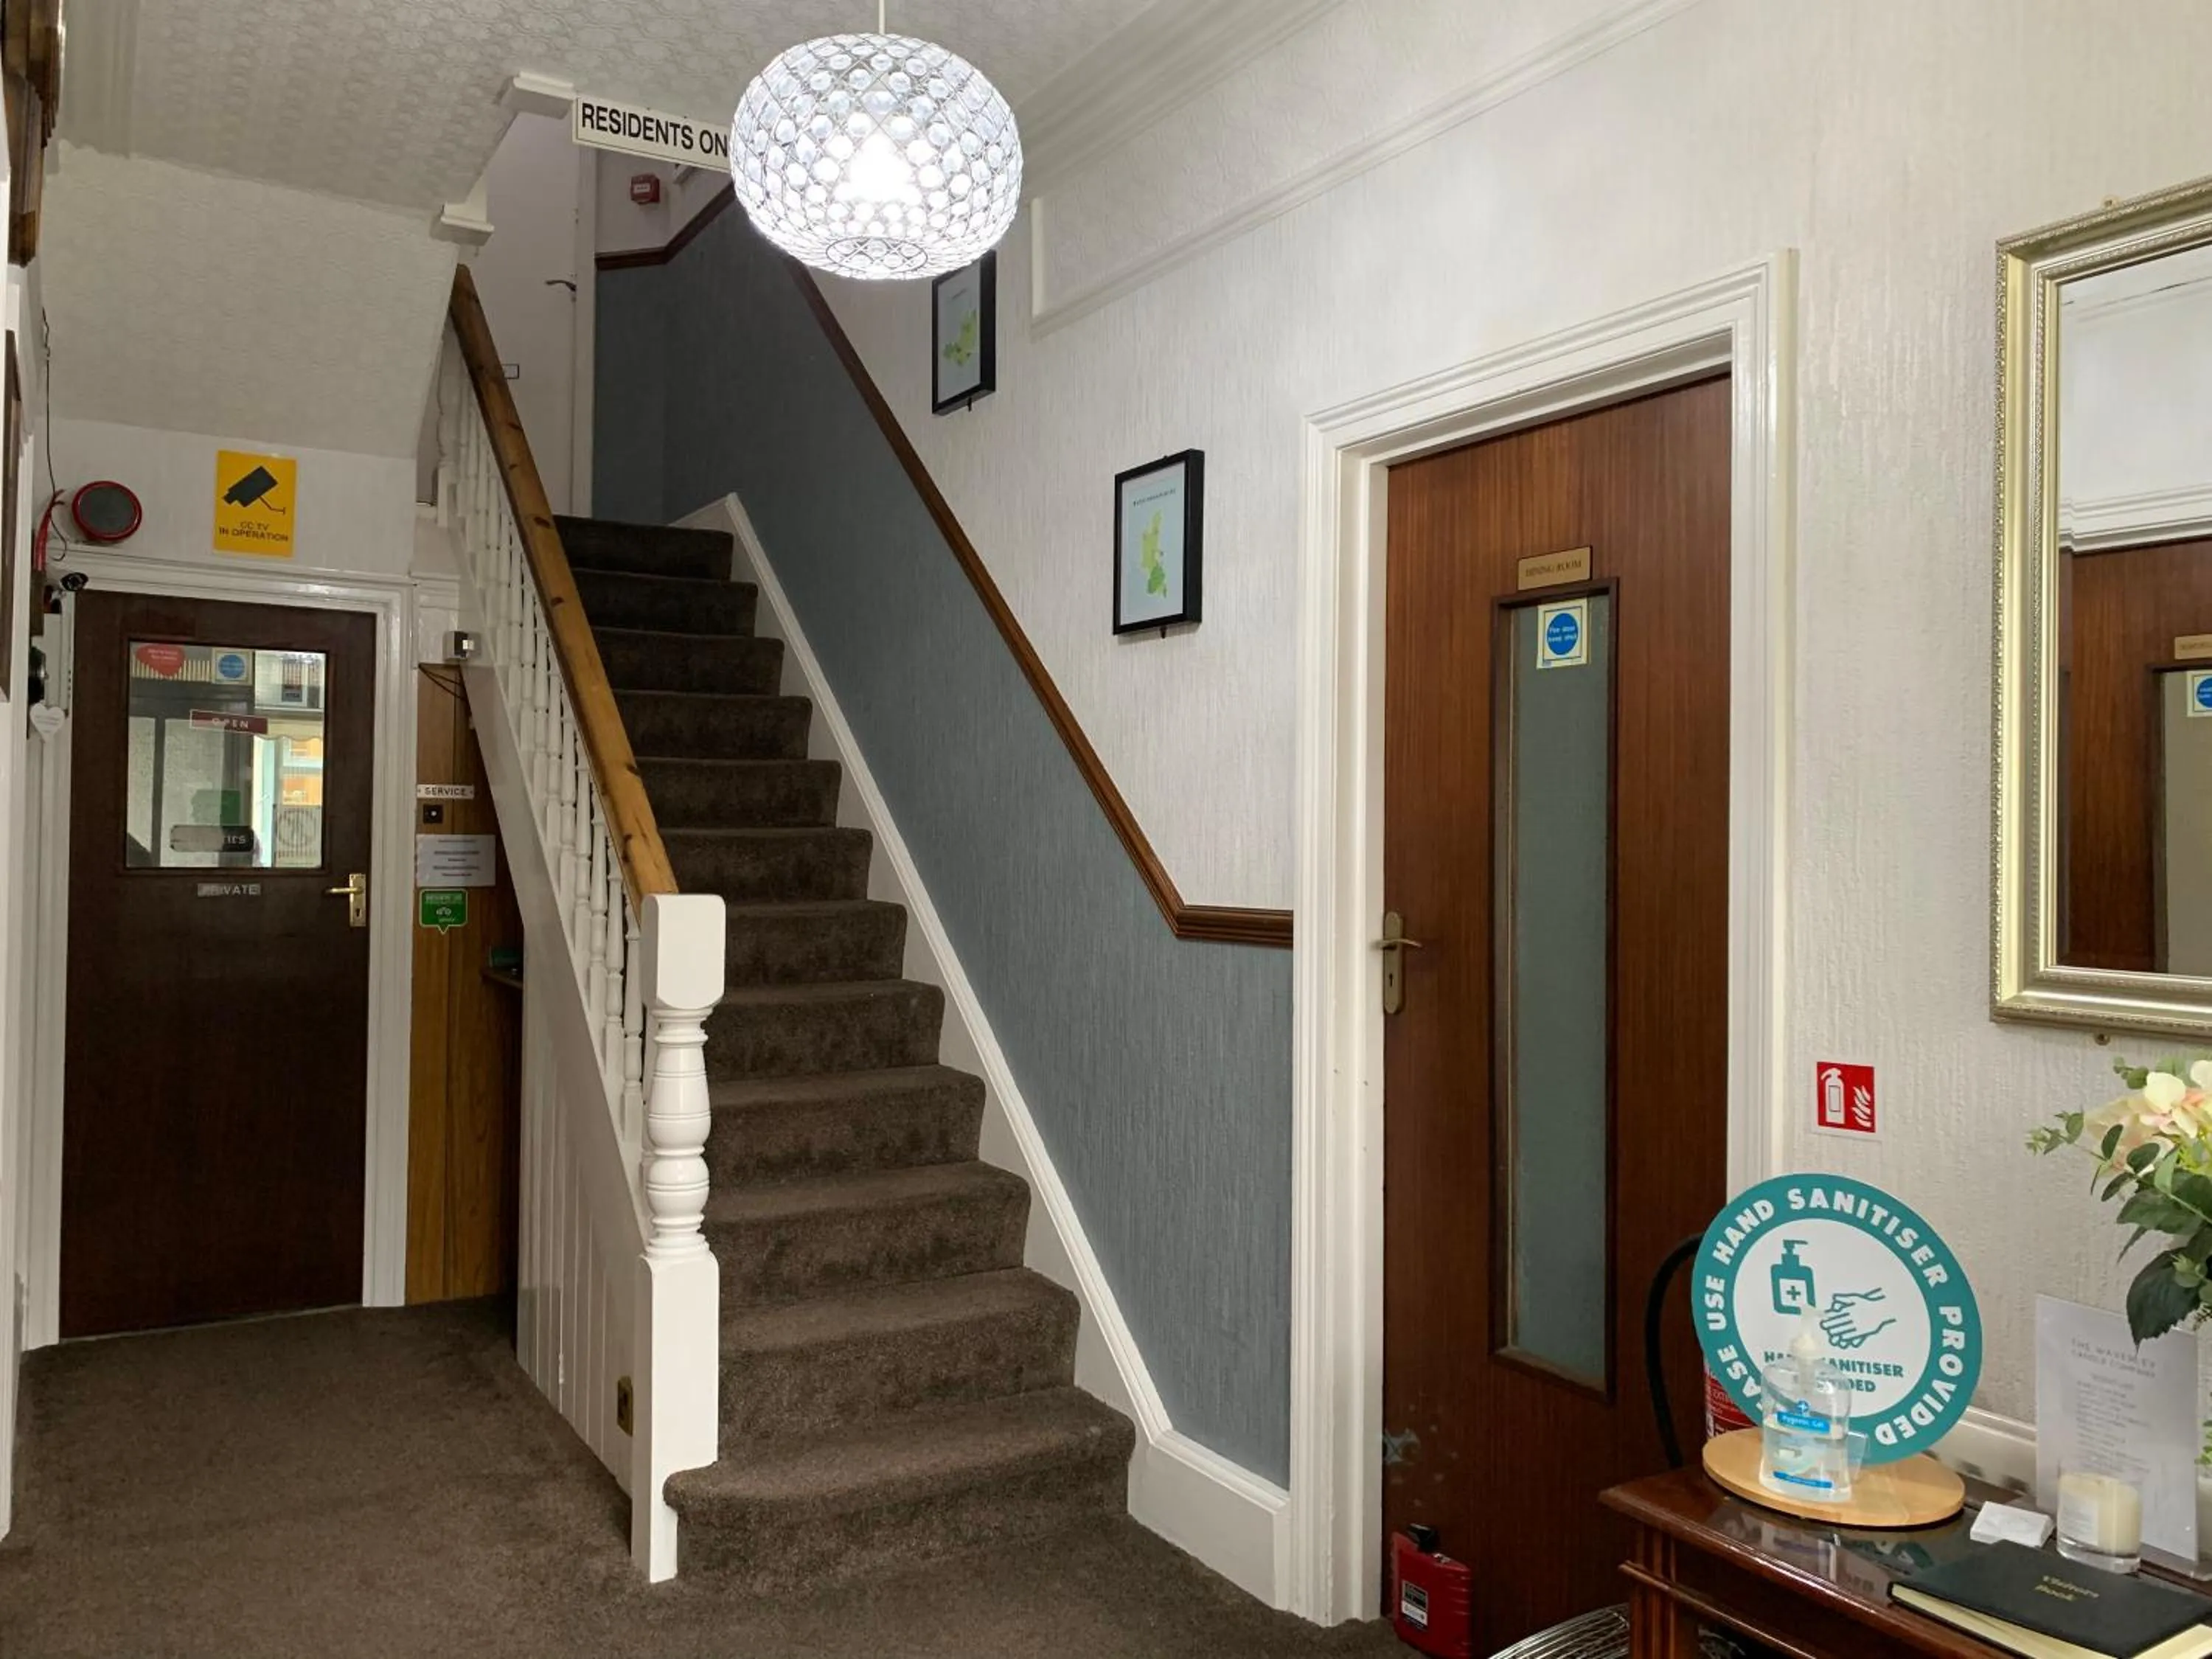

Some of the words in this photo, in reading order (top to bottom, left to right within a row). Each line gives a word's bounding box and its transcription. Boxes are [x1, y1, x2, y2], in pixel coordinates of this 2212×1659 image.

[582, 102, 694, 150] RESIDENTS
[699, 130, 728, 157] ON
[232, 529, 288, 542] OPERATION
[212, 717, 248, 728] OPEN
[424, 787, 467, 796] SERVICE
[1712, 1199, 1775, 1266] HAND
[1787, 1188, 1949, 1288] SANITISER
[1704, 1275, 1727, 1331] USE
[1823, 1357, 1904, 1378] ANITISER
[1875, 1305, 1966, 1446] PROVIDED
